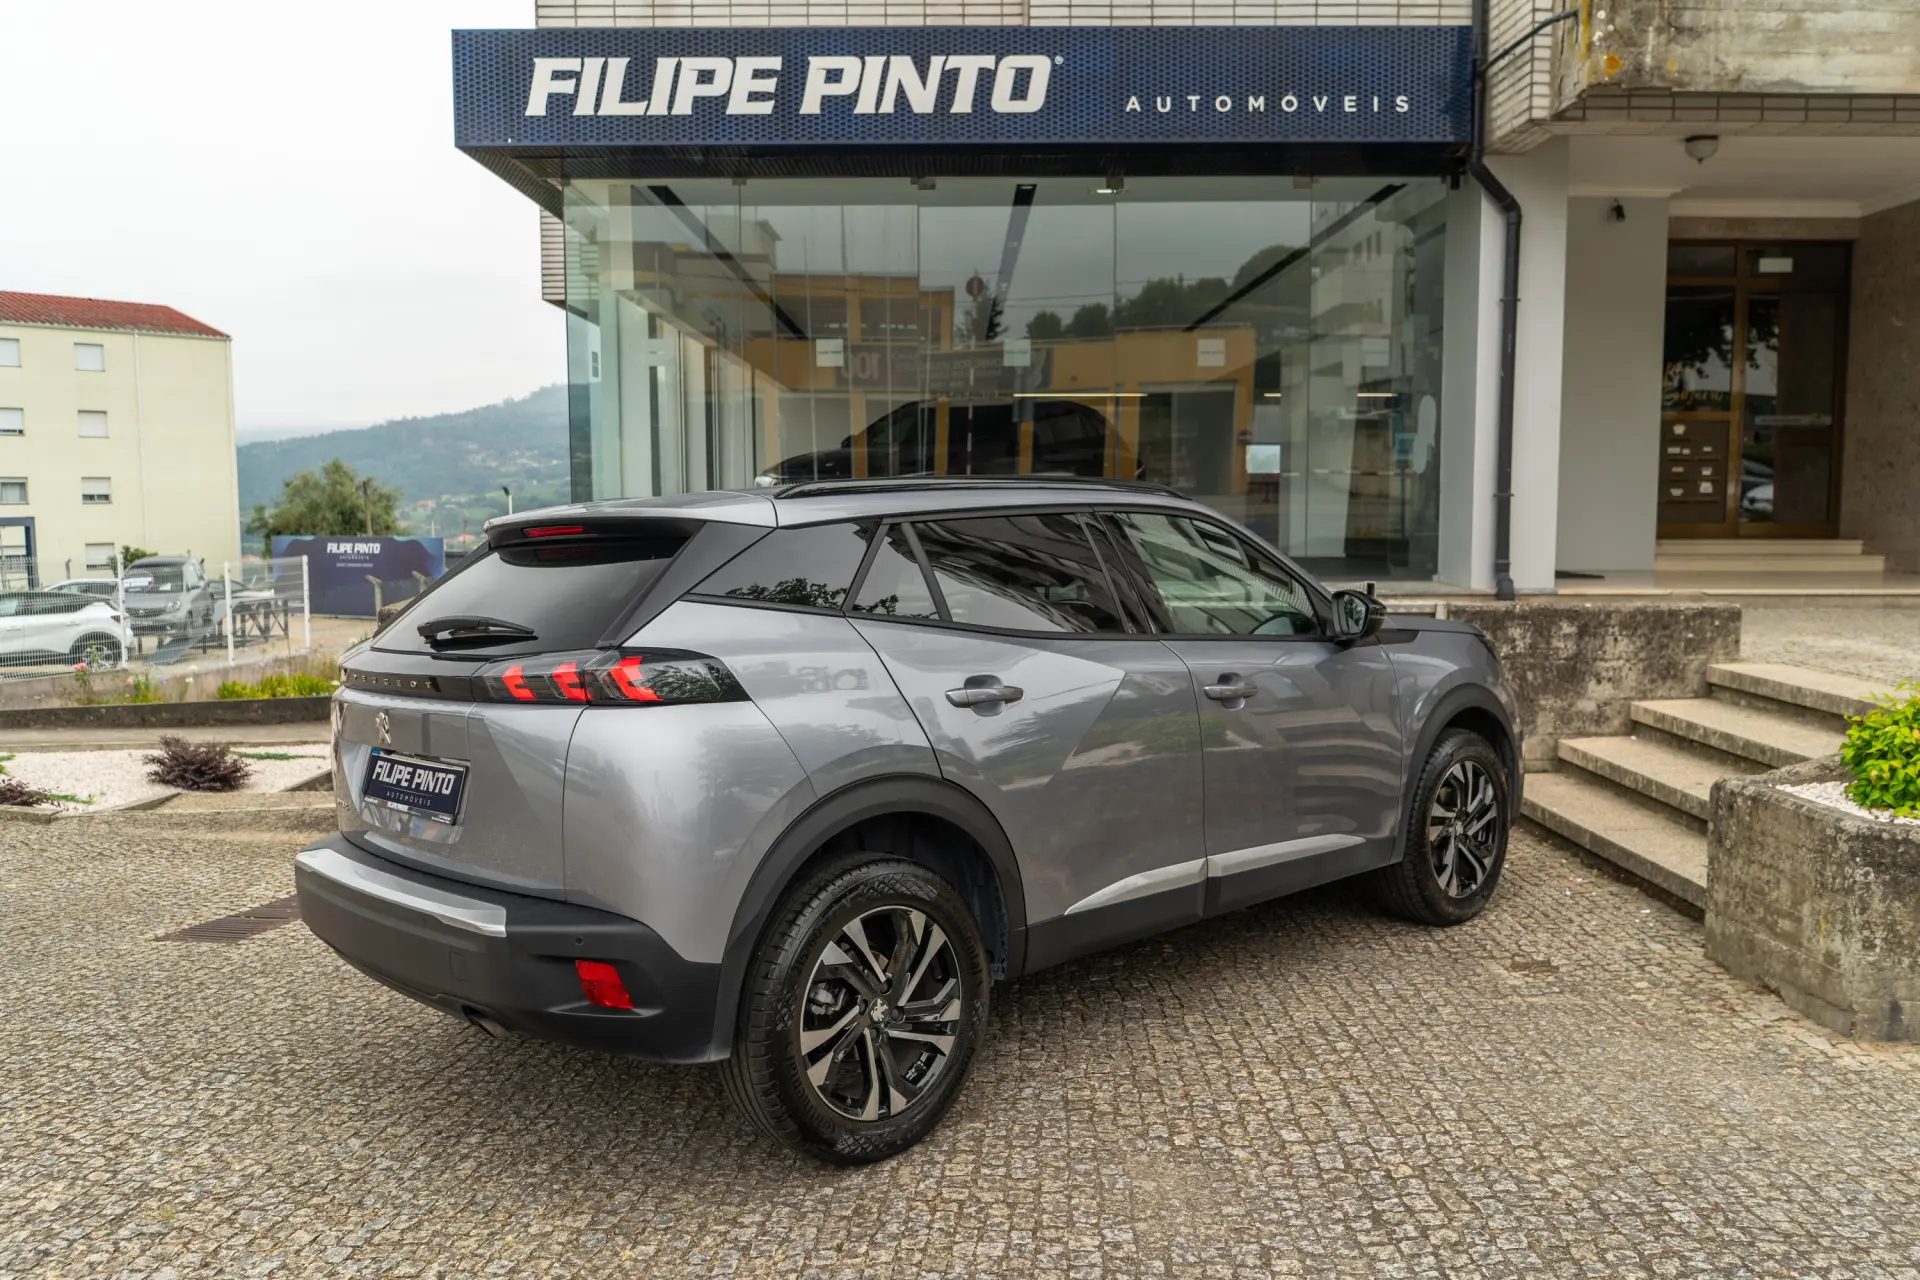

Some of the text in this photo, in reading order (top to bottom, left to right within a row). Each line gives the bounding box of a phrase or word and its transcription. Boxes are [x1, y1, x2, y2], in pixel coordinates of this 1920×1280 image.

[524, 55, 1053, 116] FILIPE PINTO
[327, 542, 380, 554] FILIPE PINTO
[372, 760, 455, 795] FILIPE PINTO
